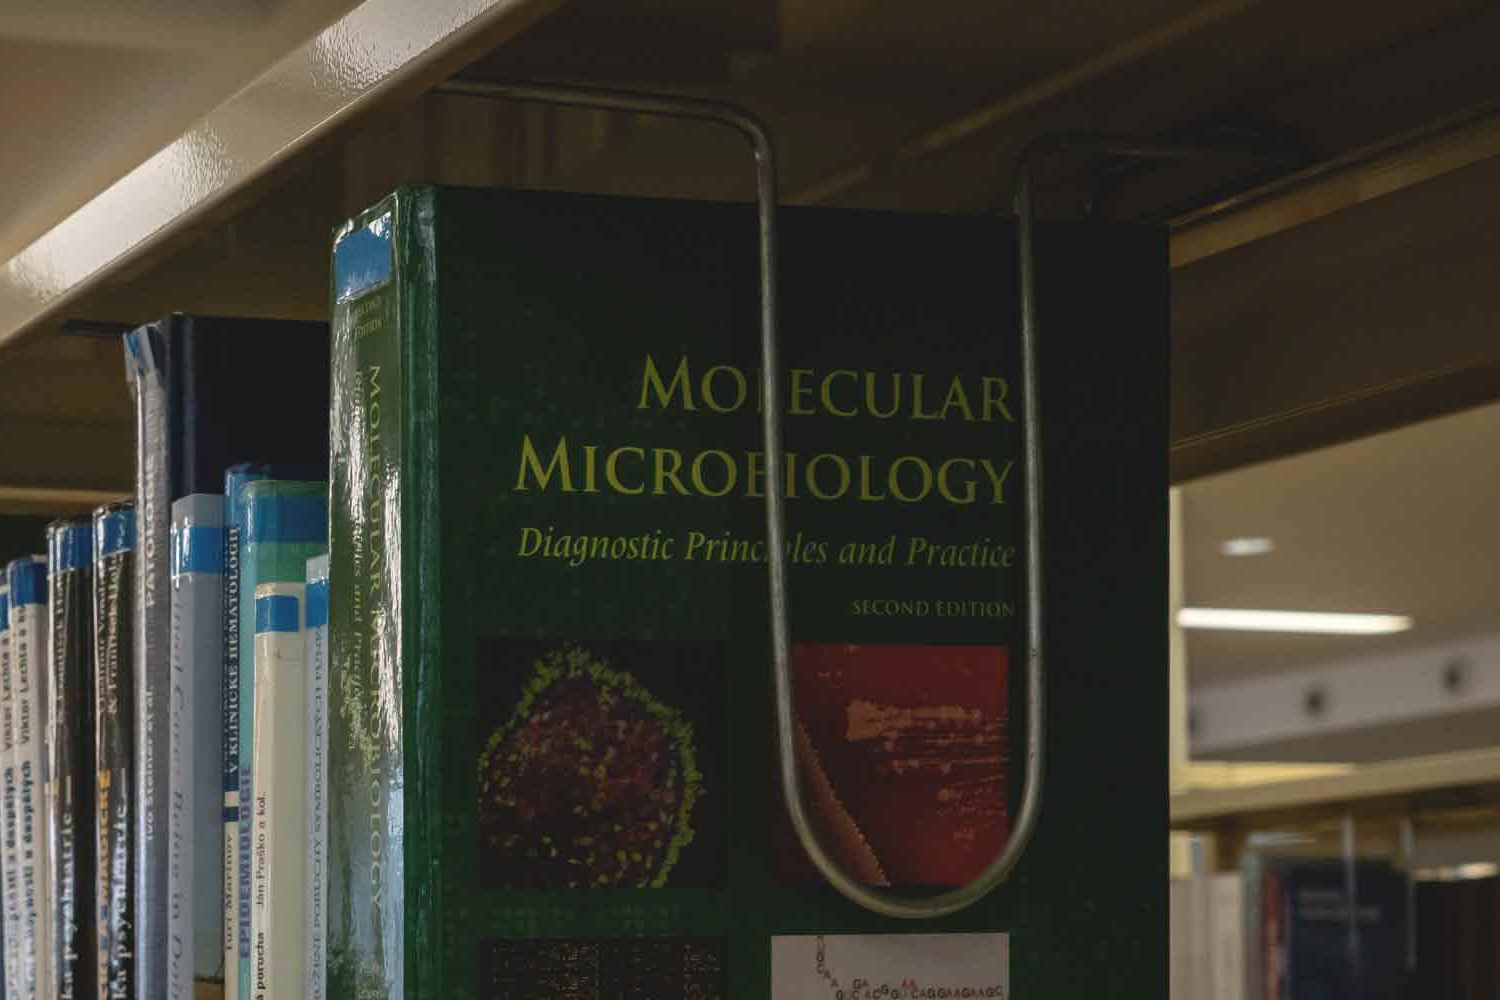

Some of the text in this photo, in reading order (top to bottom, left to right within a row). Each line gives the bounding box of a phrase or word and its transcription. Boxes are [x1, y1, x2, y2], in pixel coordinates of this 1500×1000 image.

[370, 365, 381, 593] MOLECULAR
[516, 525, 1017, 568] Diagnostic Princles and Practice
[851, 599, 1015, 618] SECOND EDITION
[0, 654, 11, 703] Lechta
[18, 642, 29, 693] Lechta
[3, 706, 13, 753] Viktor
[20, 697, 31, 745] Viktor
[255, 791, 266, 816] kol.
[255, 833, 266, 880] Praško
[253, 932, 266, 991] porucha
